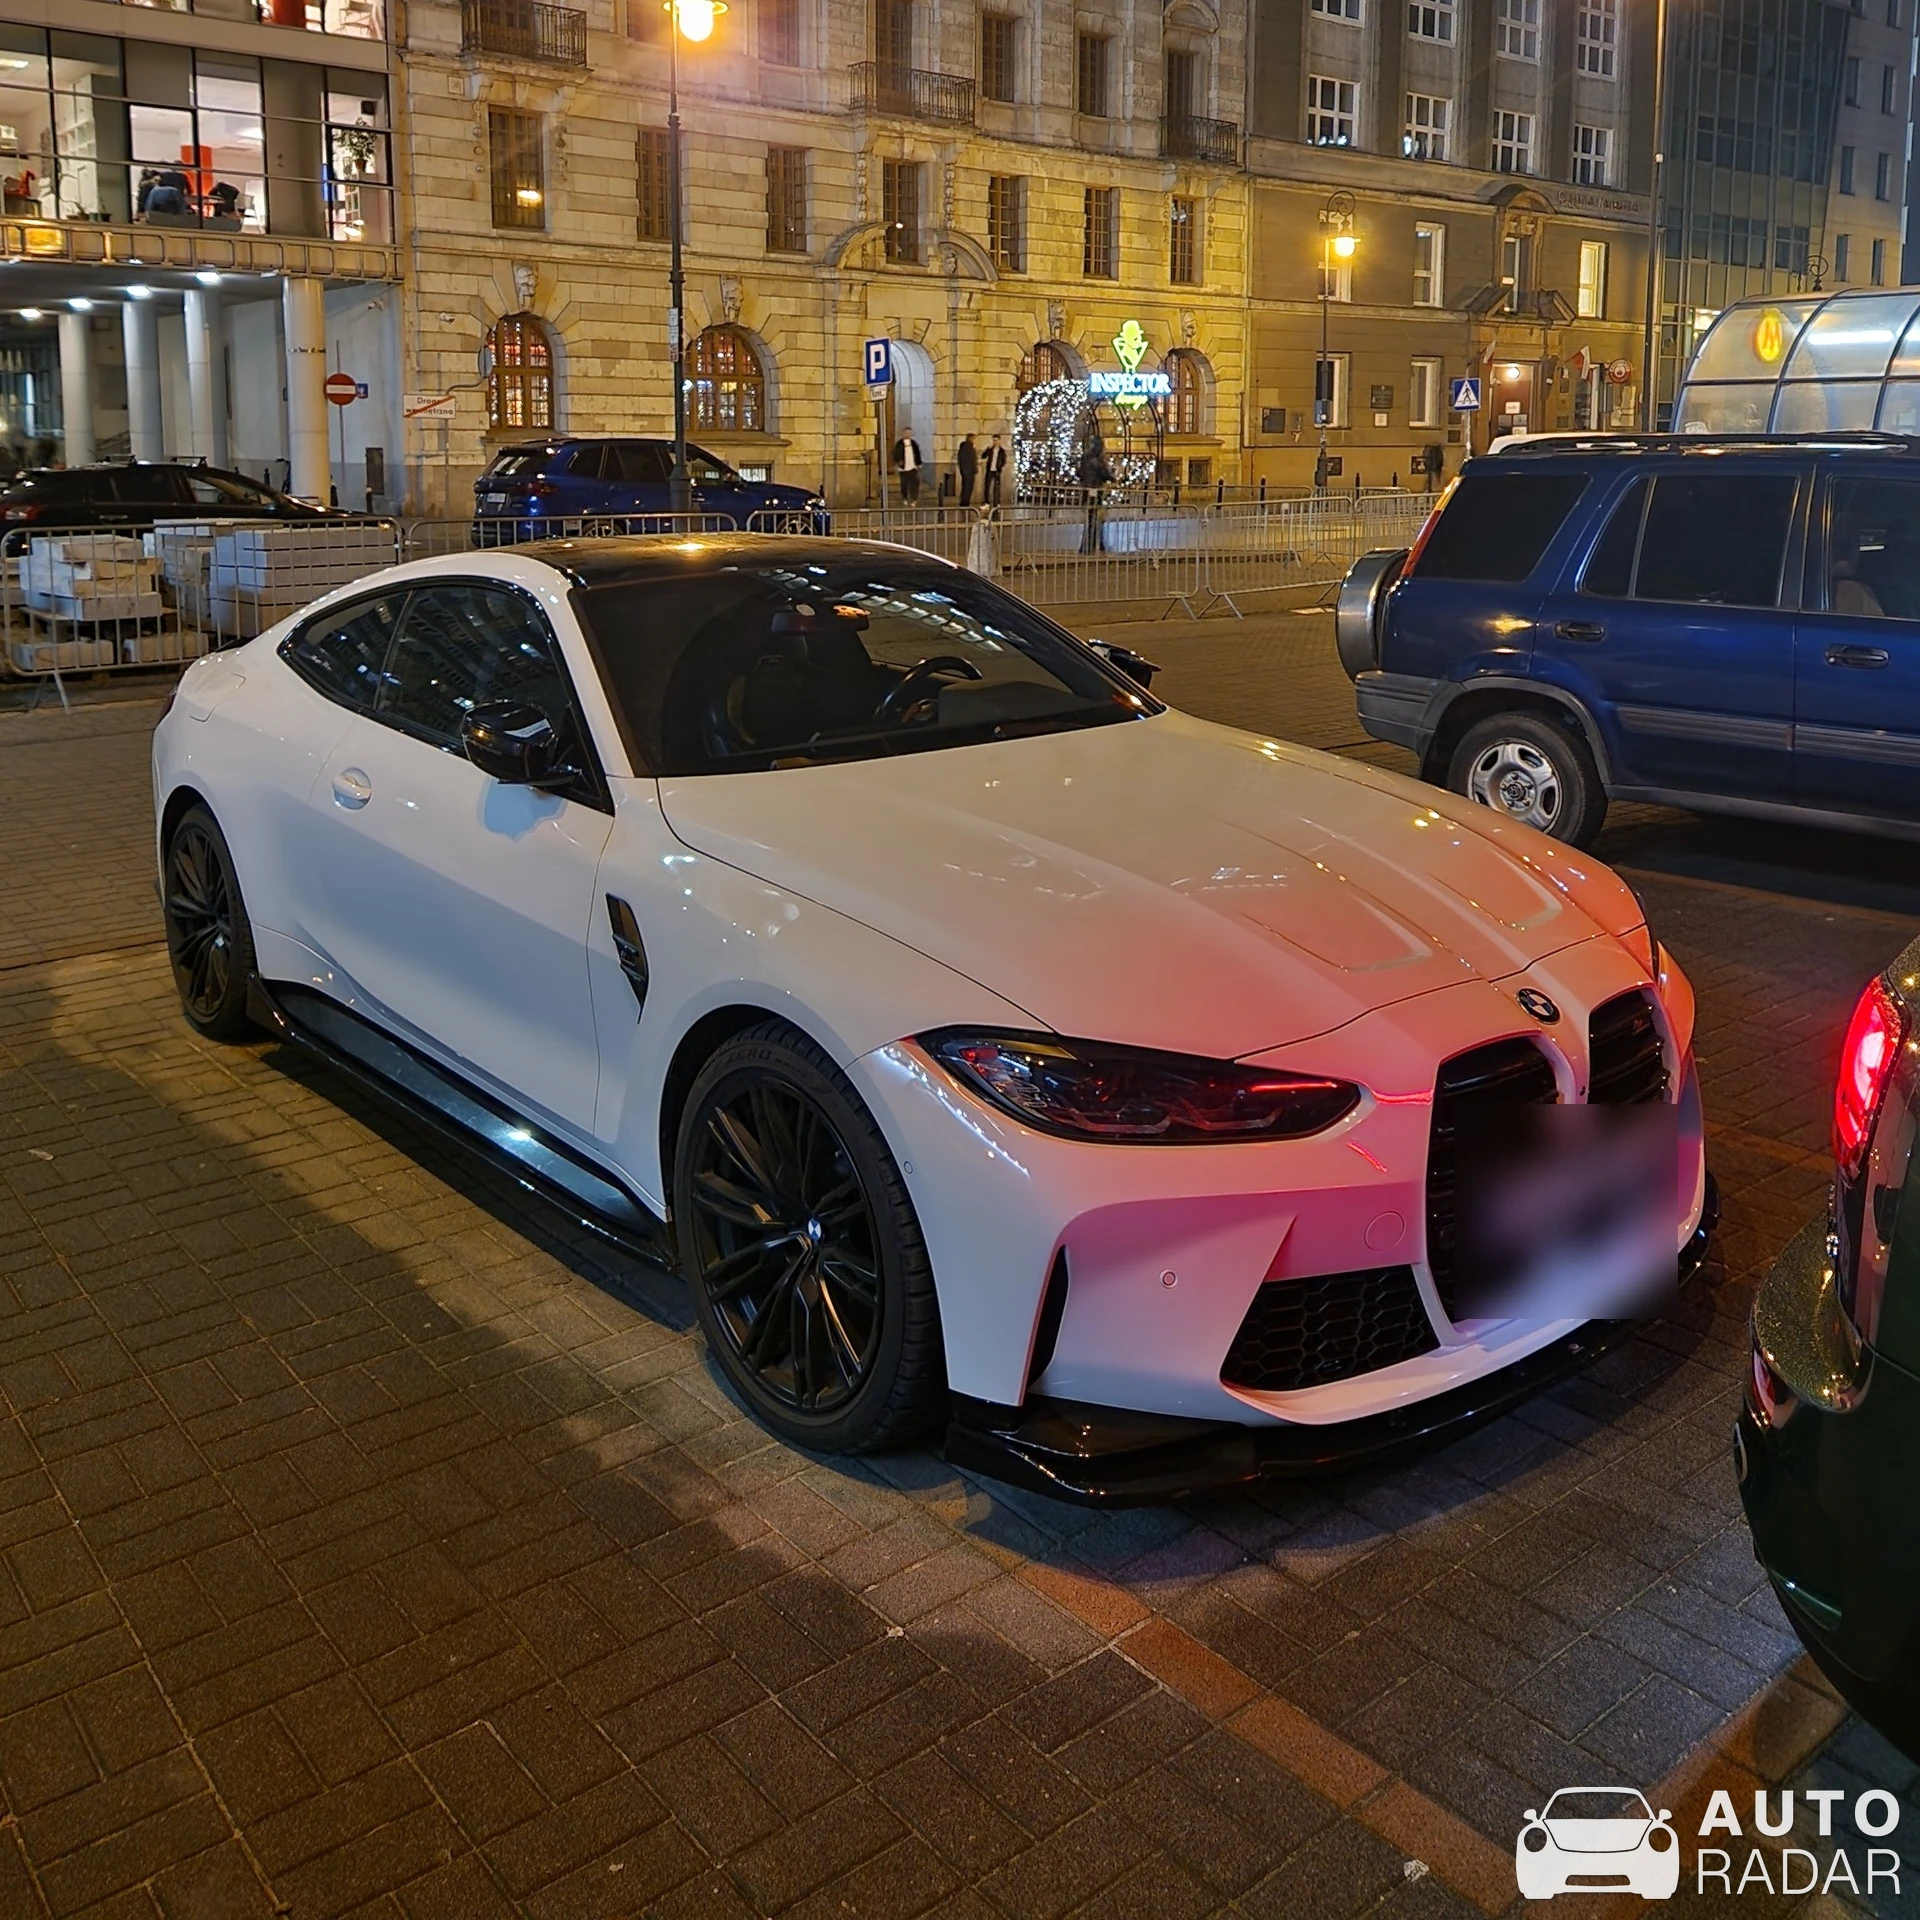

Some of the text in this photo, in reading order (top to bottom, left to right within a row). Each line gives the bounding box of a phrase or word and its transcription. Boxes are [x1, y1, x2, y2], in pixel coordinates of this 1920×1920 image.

[870, 344, 886, 380] P
[1091, 372, 1172, 393] INSPECTOR
[417, 397, 441, 405] Dro
